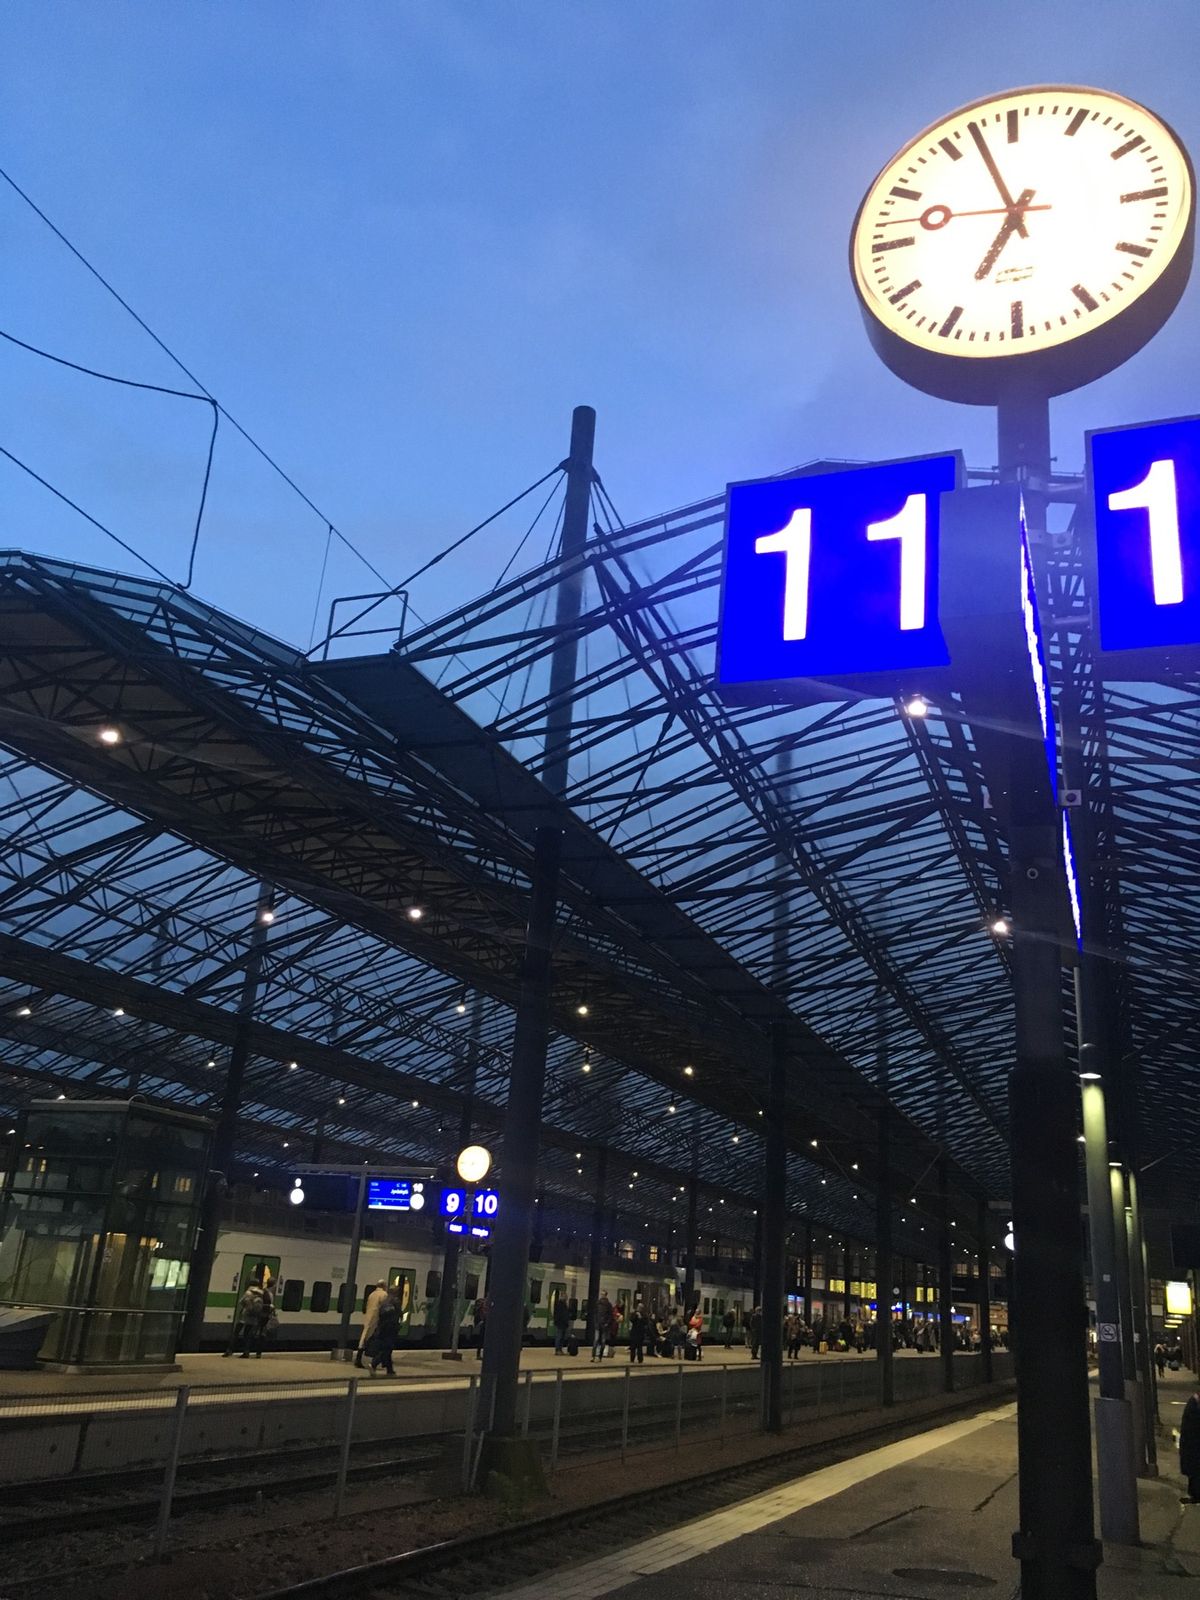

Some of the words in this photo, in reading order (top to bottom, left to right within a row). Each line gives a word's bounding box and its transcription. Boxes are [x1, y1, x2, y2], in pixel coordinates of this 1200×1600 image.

[755, 493, 927, 641] 11
[412, 1182, 424, 1193] 10
[446, 1193, 460, 1213] 9
[475, 1194, 498, 1214] 10
